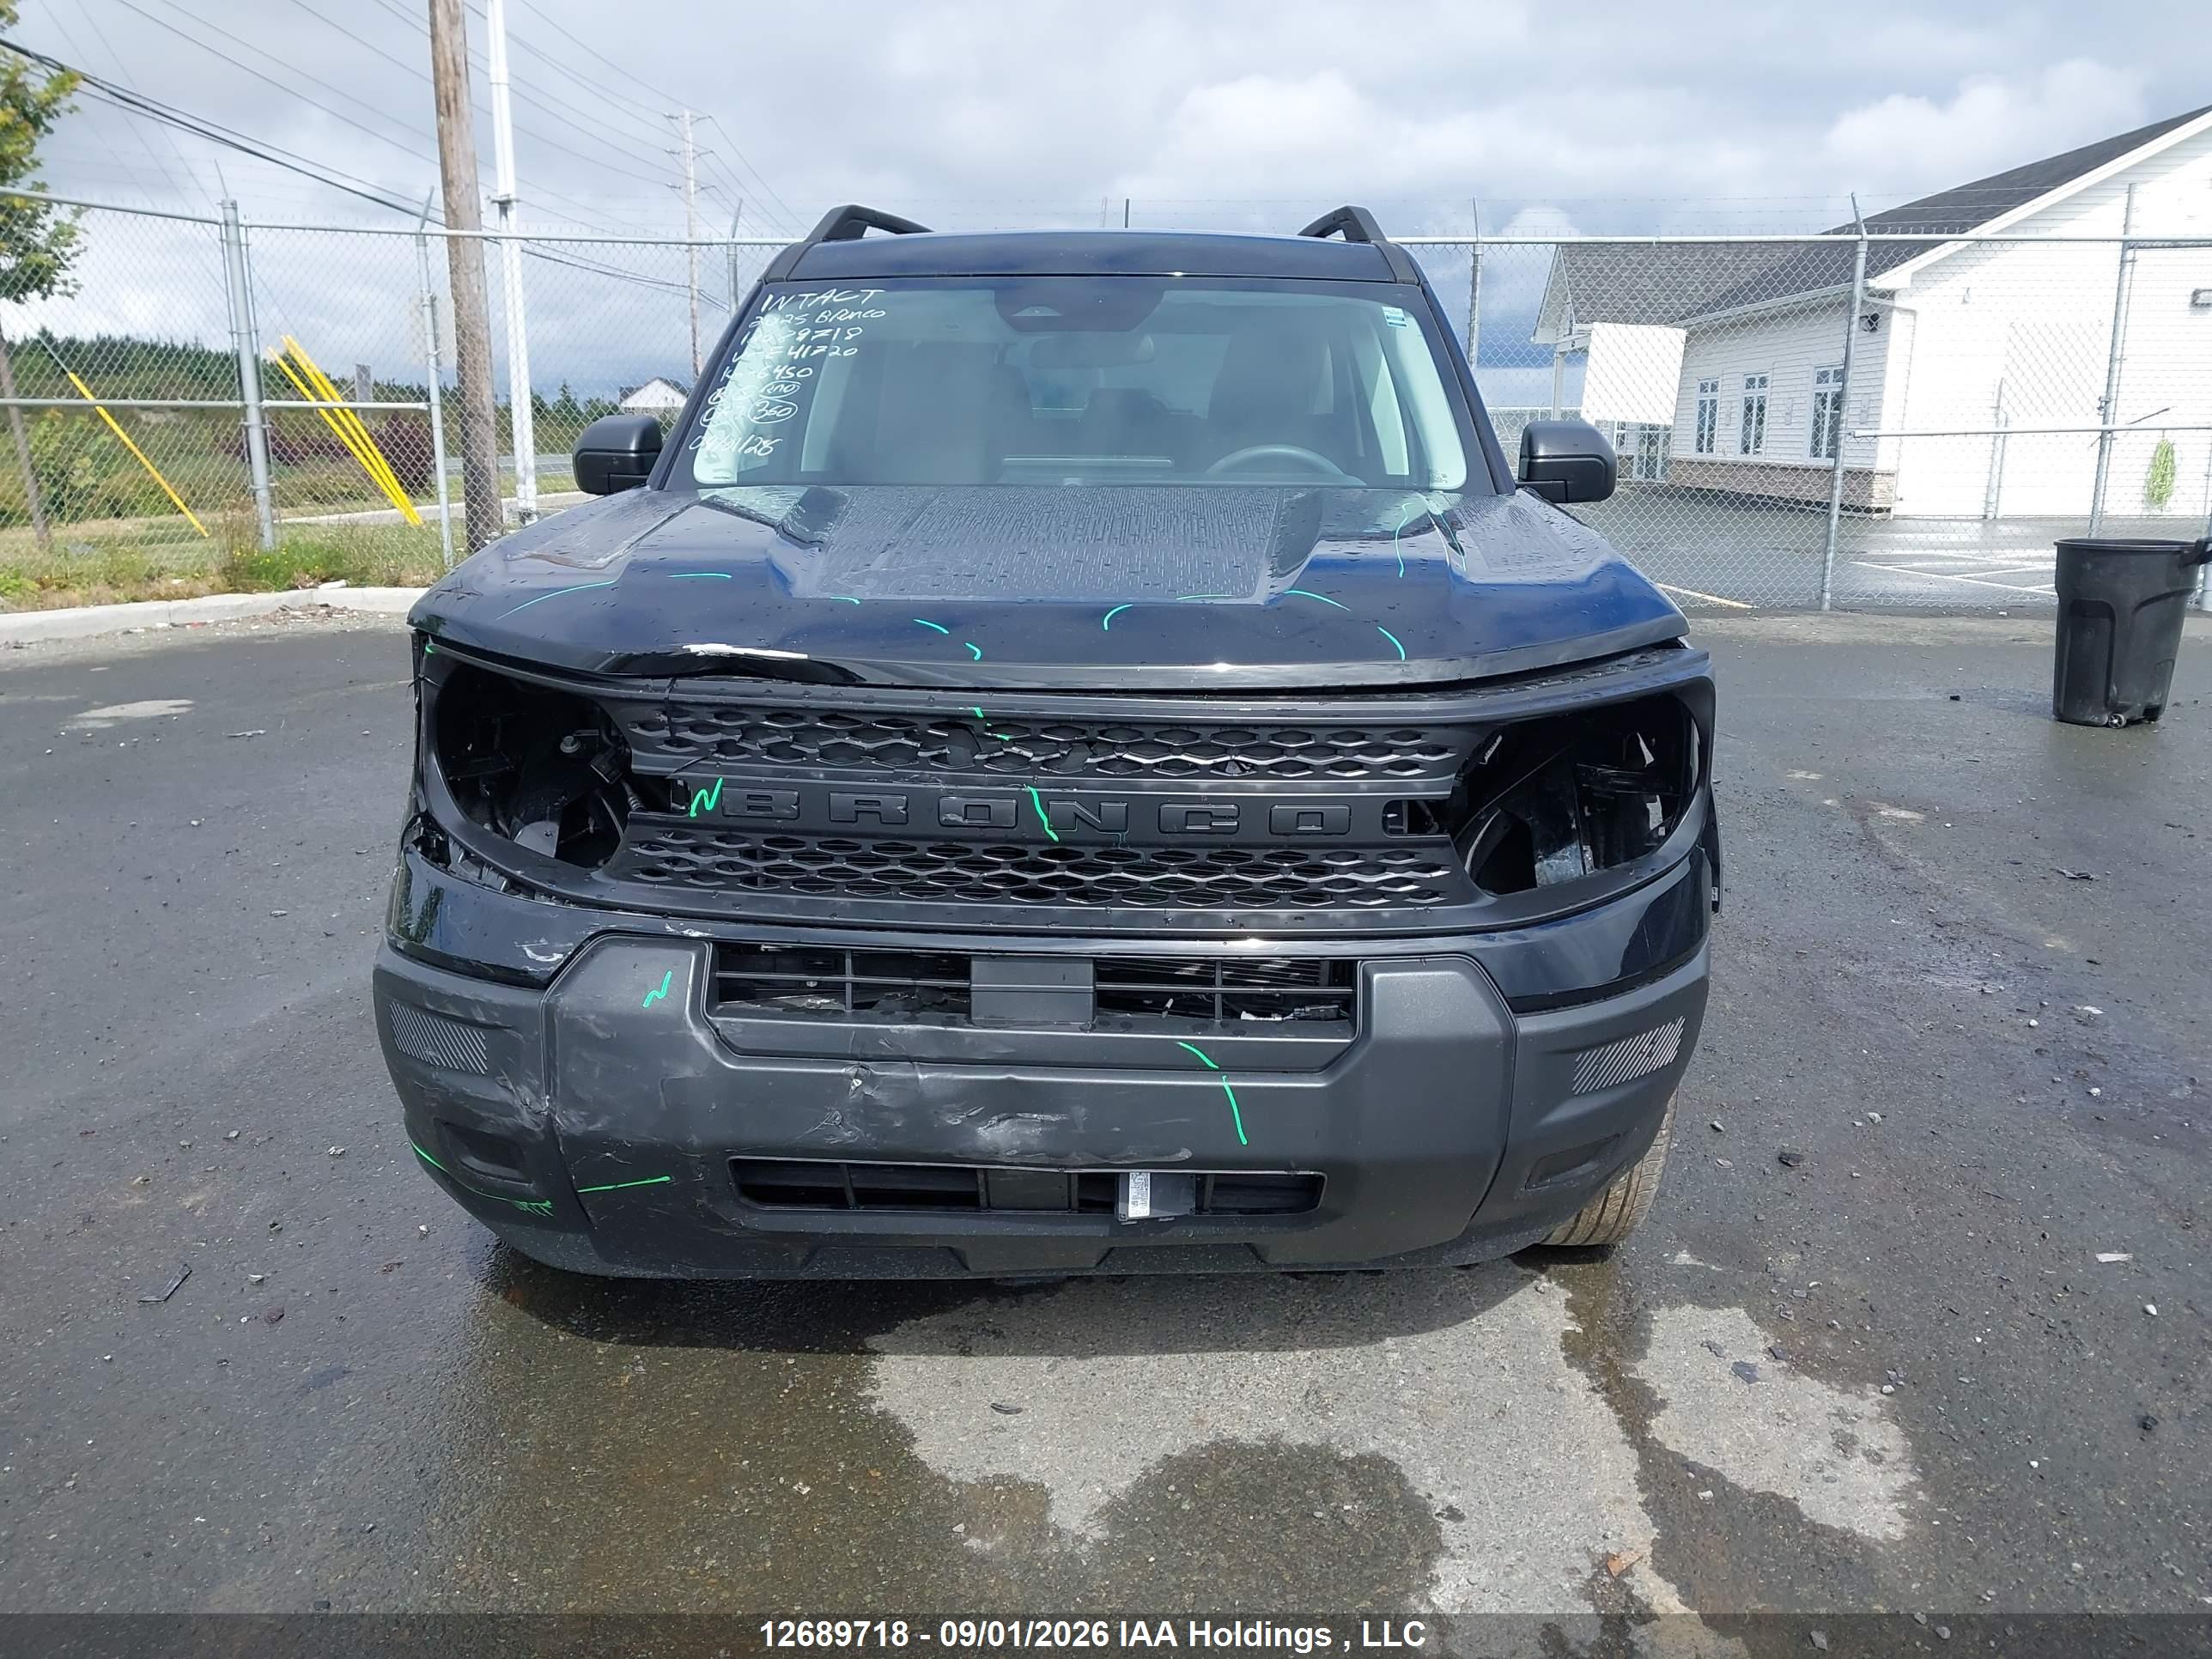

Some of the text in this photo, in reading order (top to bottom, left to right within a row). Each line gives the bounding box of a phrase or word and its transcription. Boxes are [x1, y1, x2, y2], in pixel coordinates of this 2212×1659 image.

[761, 288, 886, 313] INTACT
[748, 313, 811, 329] 2025
[757, 364, 813, 380] 6450
[752, 400, 793, 420] 360
[721, 787, 1352, 835] BRONCO
